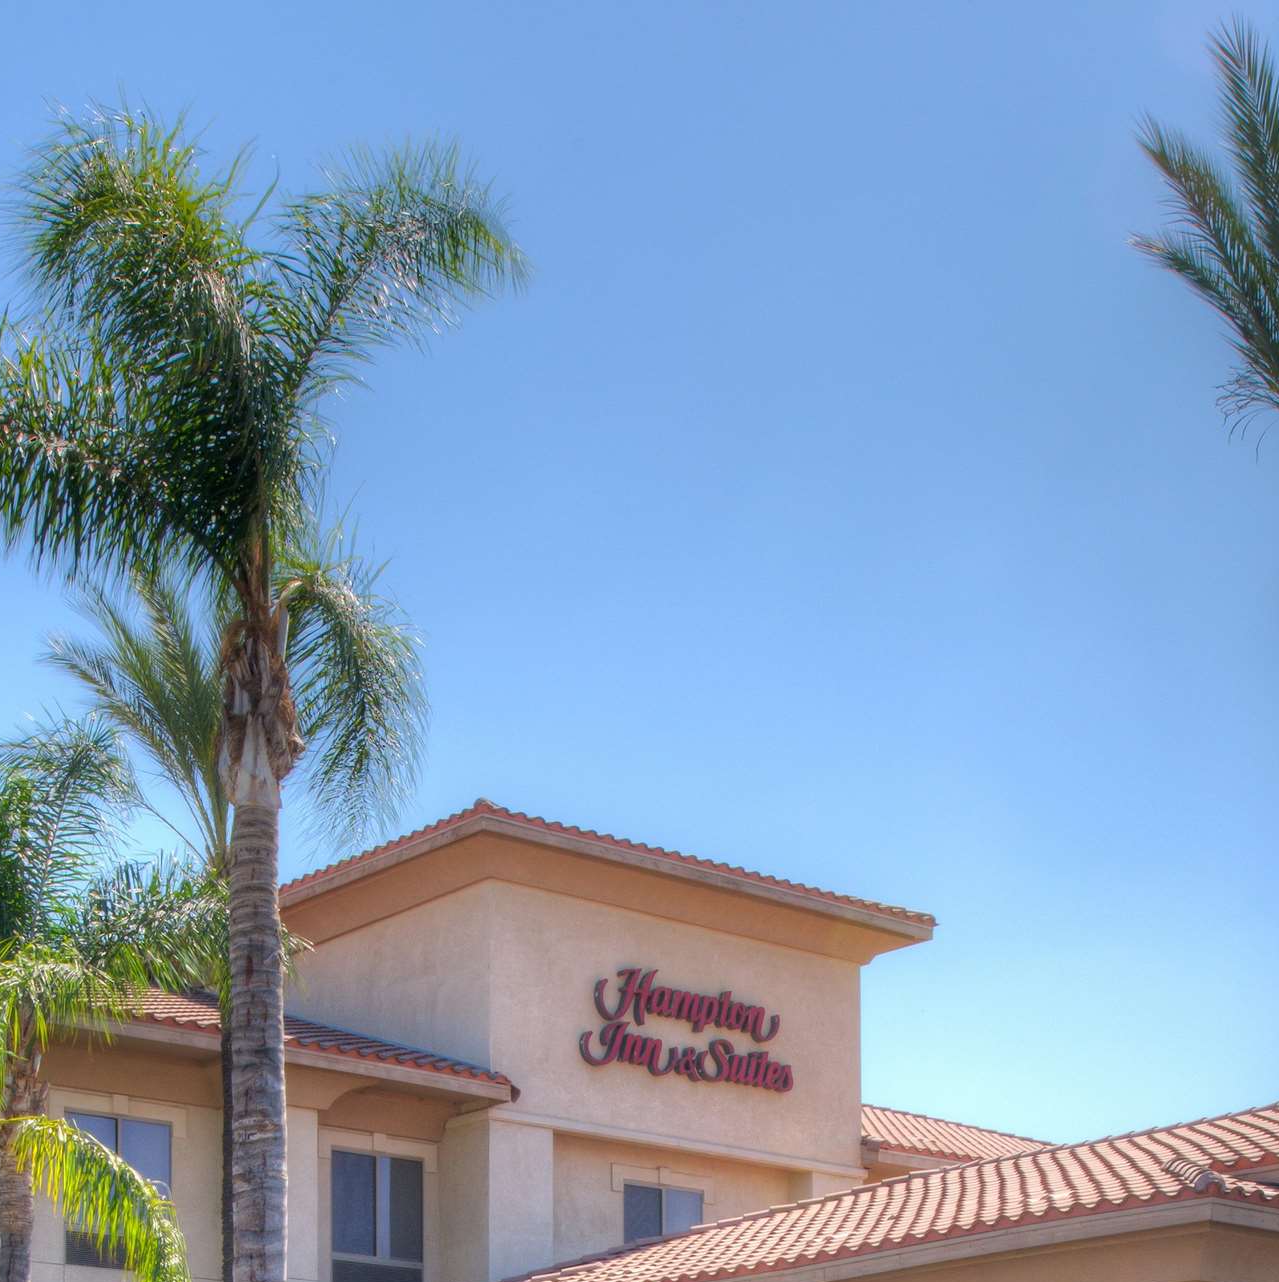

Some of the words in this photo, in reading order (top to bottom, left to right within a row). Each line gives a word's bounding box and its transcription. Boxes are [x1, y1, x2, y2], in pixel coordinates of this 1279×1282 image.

[593, 968, 780, 1043] Hampton
[579, 1021, 678, 1076] Inn
[674, 1046, 701, 1082] &
[696, 1038, 794, 1092] Suites
